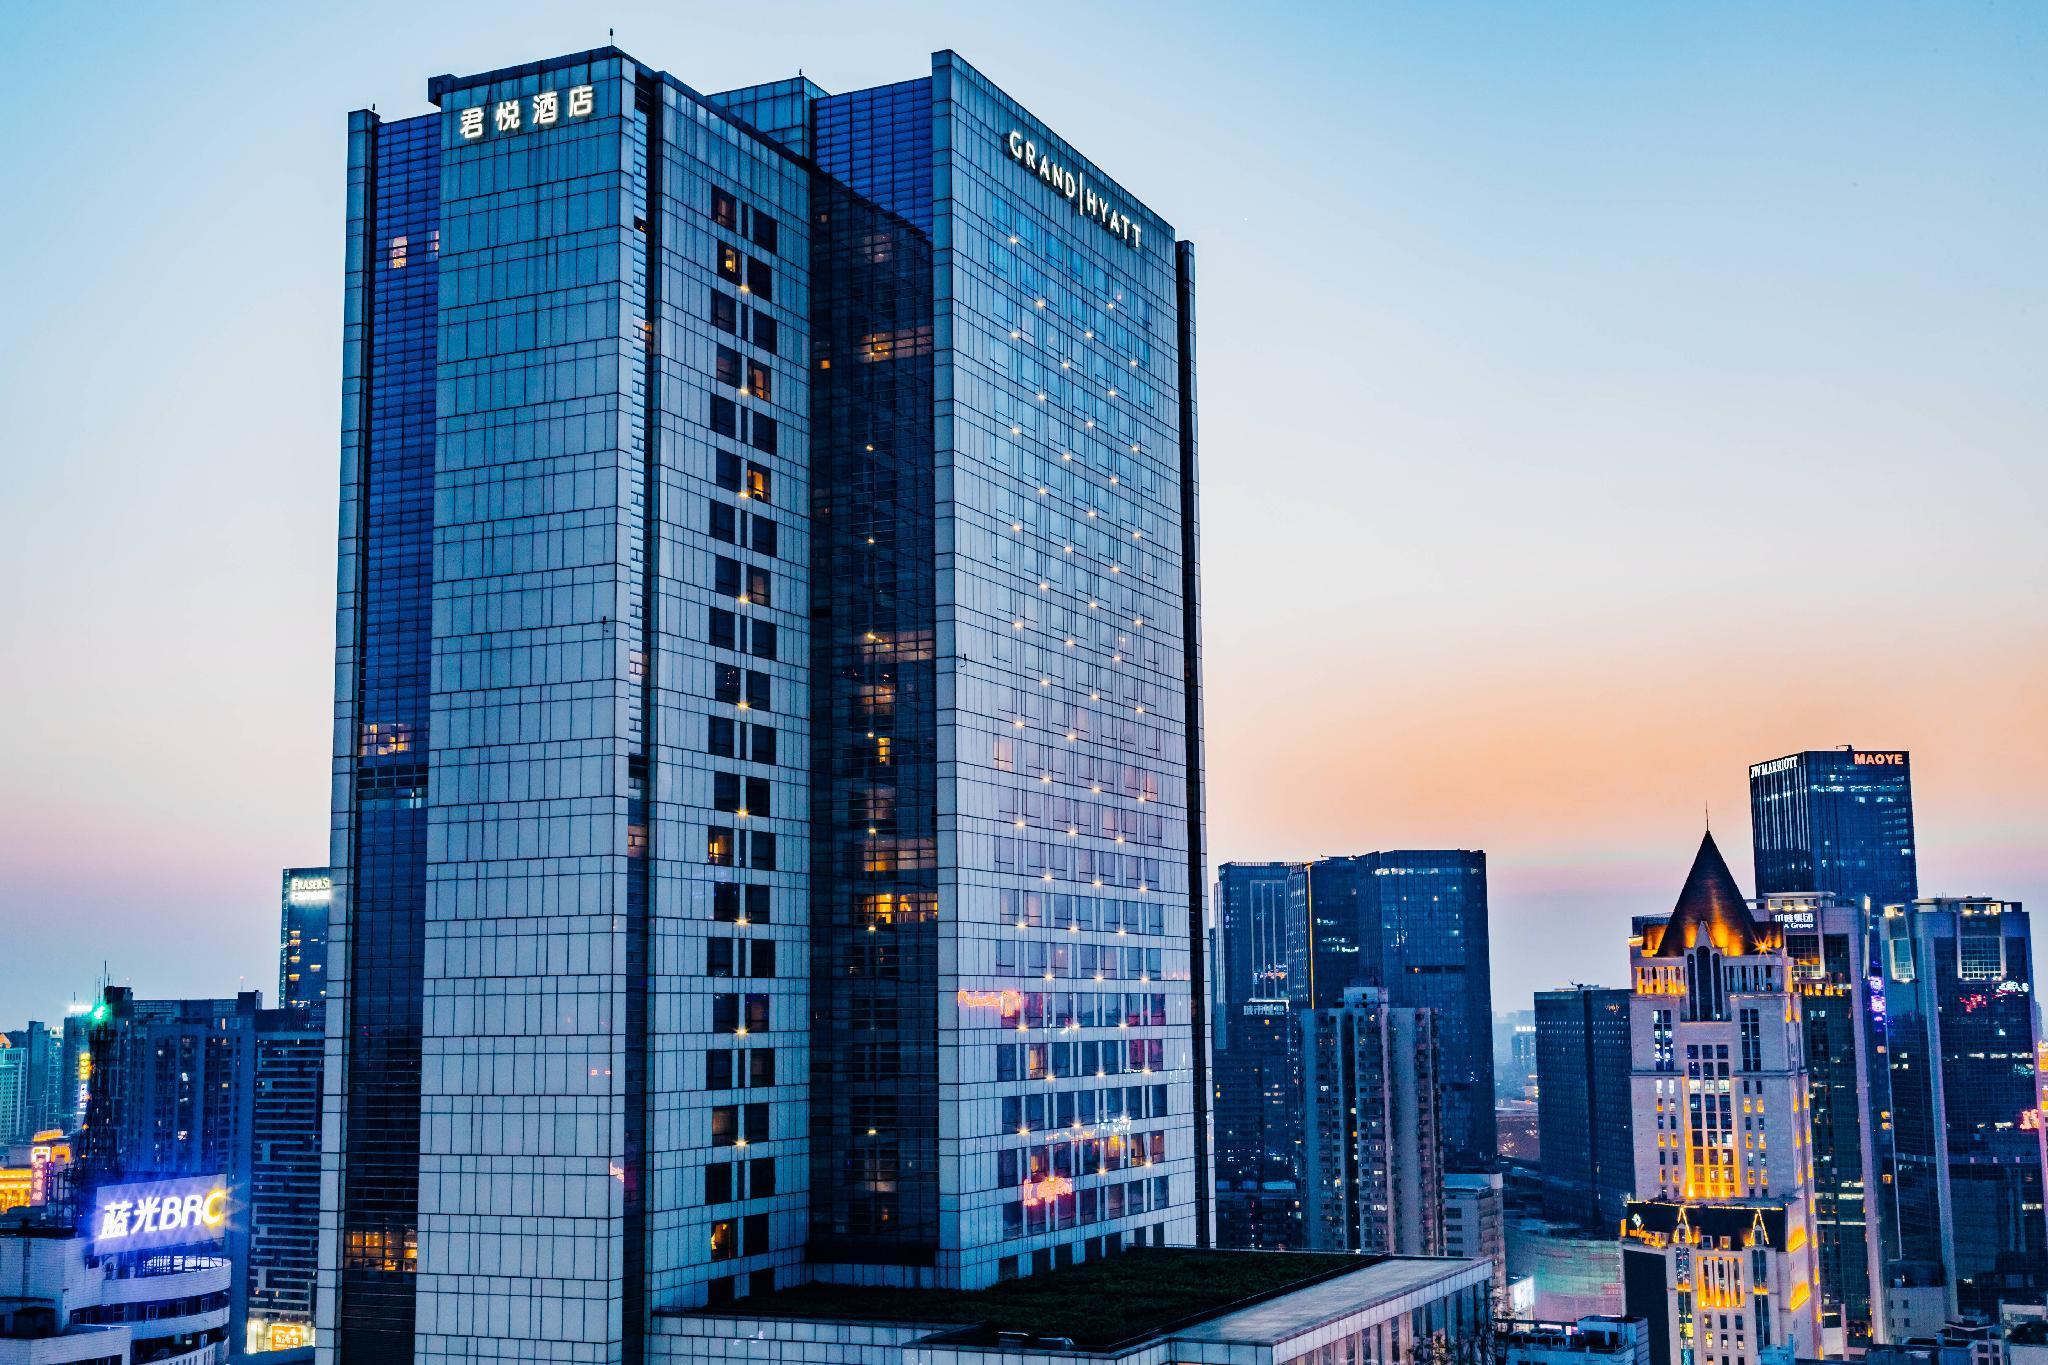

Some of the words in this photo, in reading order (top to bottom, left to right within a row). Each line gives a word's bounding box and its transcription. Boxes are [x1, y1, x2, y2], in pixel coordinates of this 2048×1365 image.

[459, 85, 593, 139] 君悦酒店
[1009, 130, 1076, 198] GRAND
[1086, 188, 1142, 248] HYATT
[1761, 755, 1798, 776] MARRIOTT
[1854, 753, 1904, 765] MAOYE
